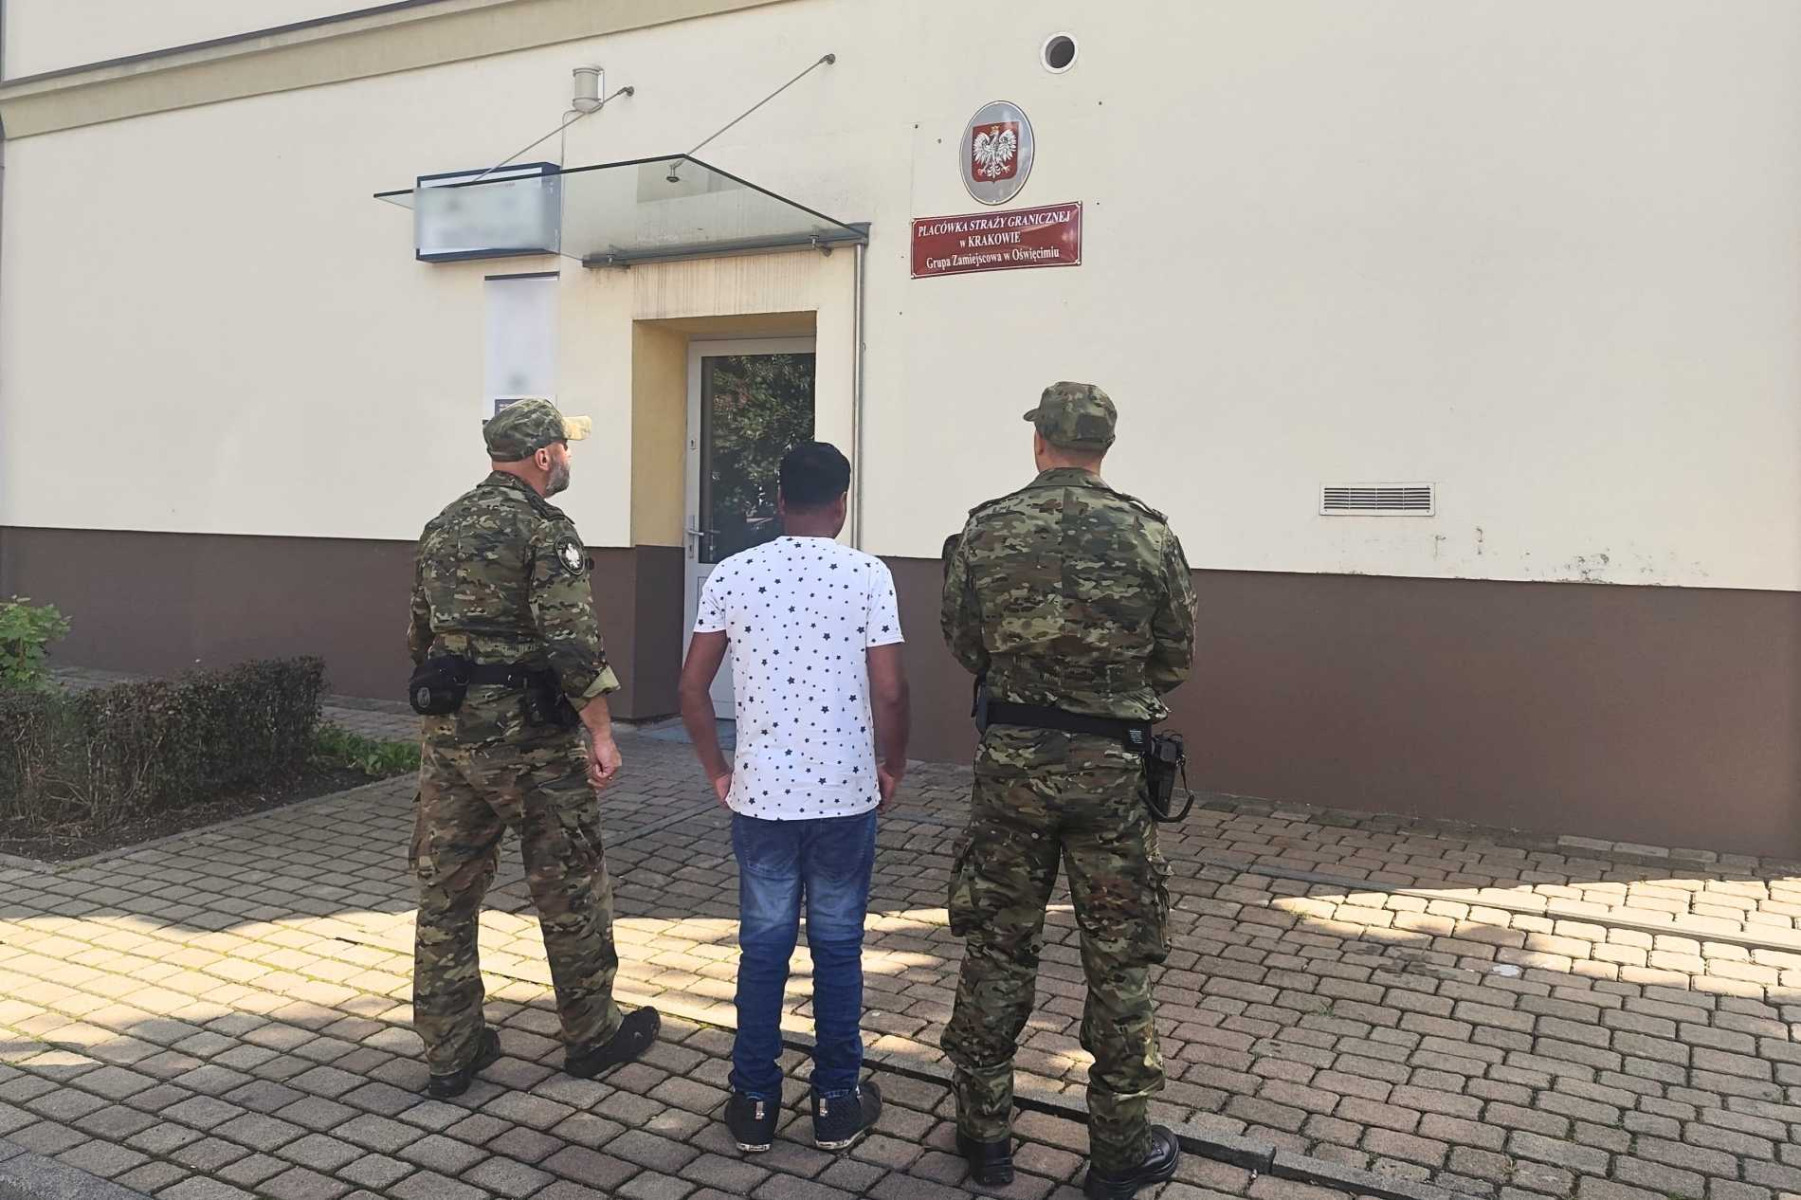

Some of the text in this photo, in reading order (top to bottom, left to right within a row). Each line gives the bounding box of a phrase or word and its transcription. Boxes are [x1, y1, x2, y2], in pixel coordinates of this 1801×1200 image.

[918, 210, 1071, 237] PLACÓWKA STRAŻY GRANICZNEJ
[959, 231, 1021, 248] w KRAKOWIE
[926, 246, 1060, 271] Grupa Zamiejscowa w Oświęcimiu
